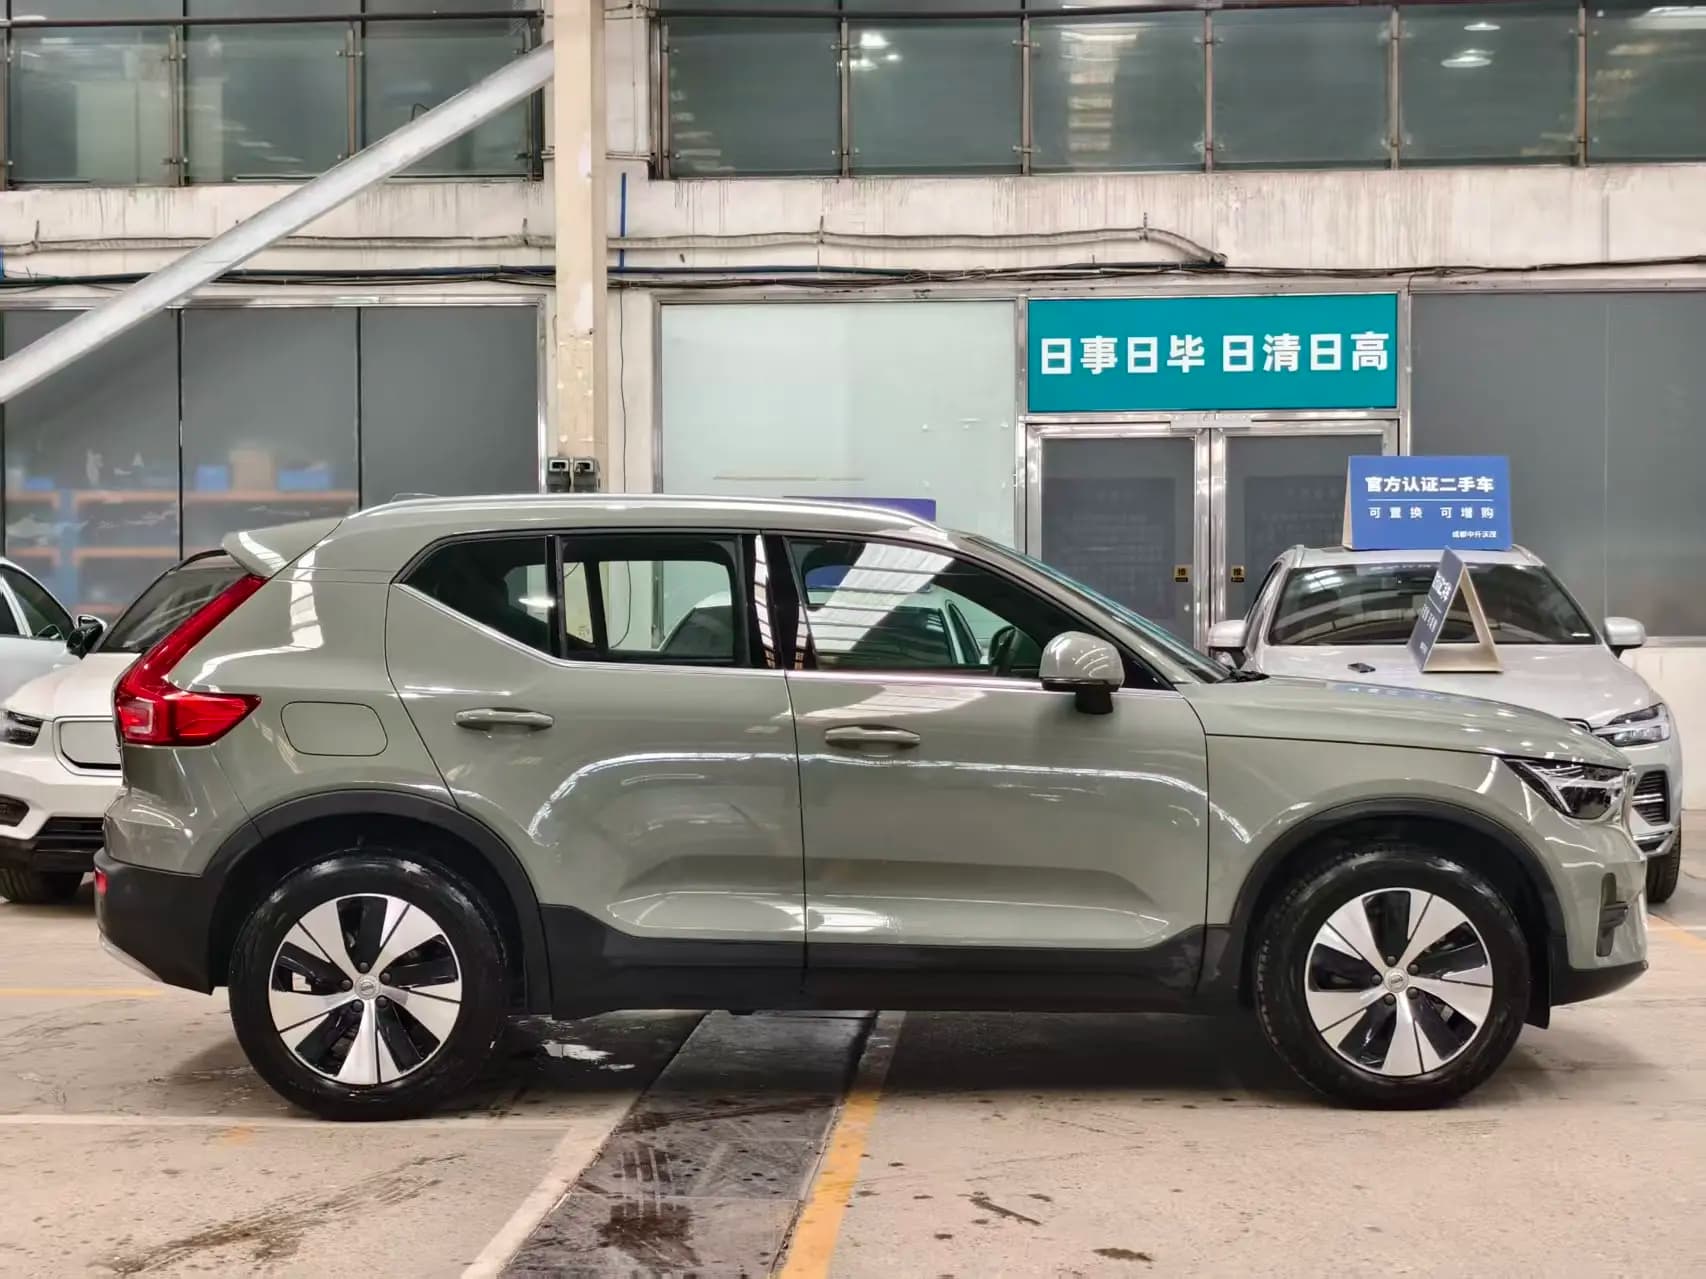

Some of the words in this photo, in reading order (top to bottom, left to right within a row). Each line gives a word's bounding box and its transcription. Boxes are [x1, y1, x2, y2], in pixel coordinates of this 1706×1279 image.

[1041, 334, 1205, 375] 日事日毕
[1222, 331, 1389, 372] 日清日高
[1365, 476, 1494, 492] 官方认证二手车
